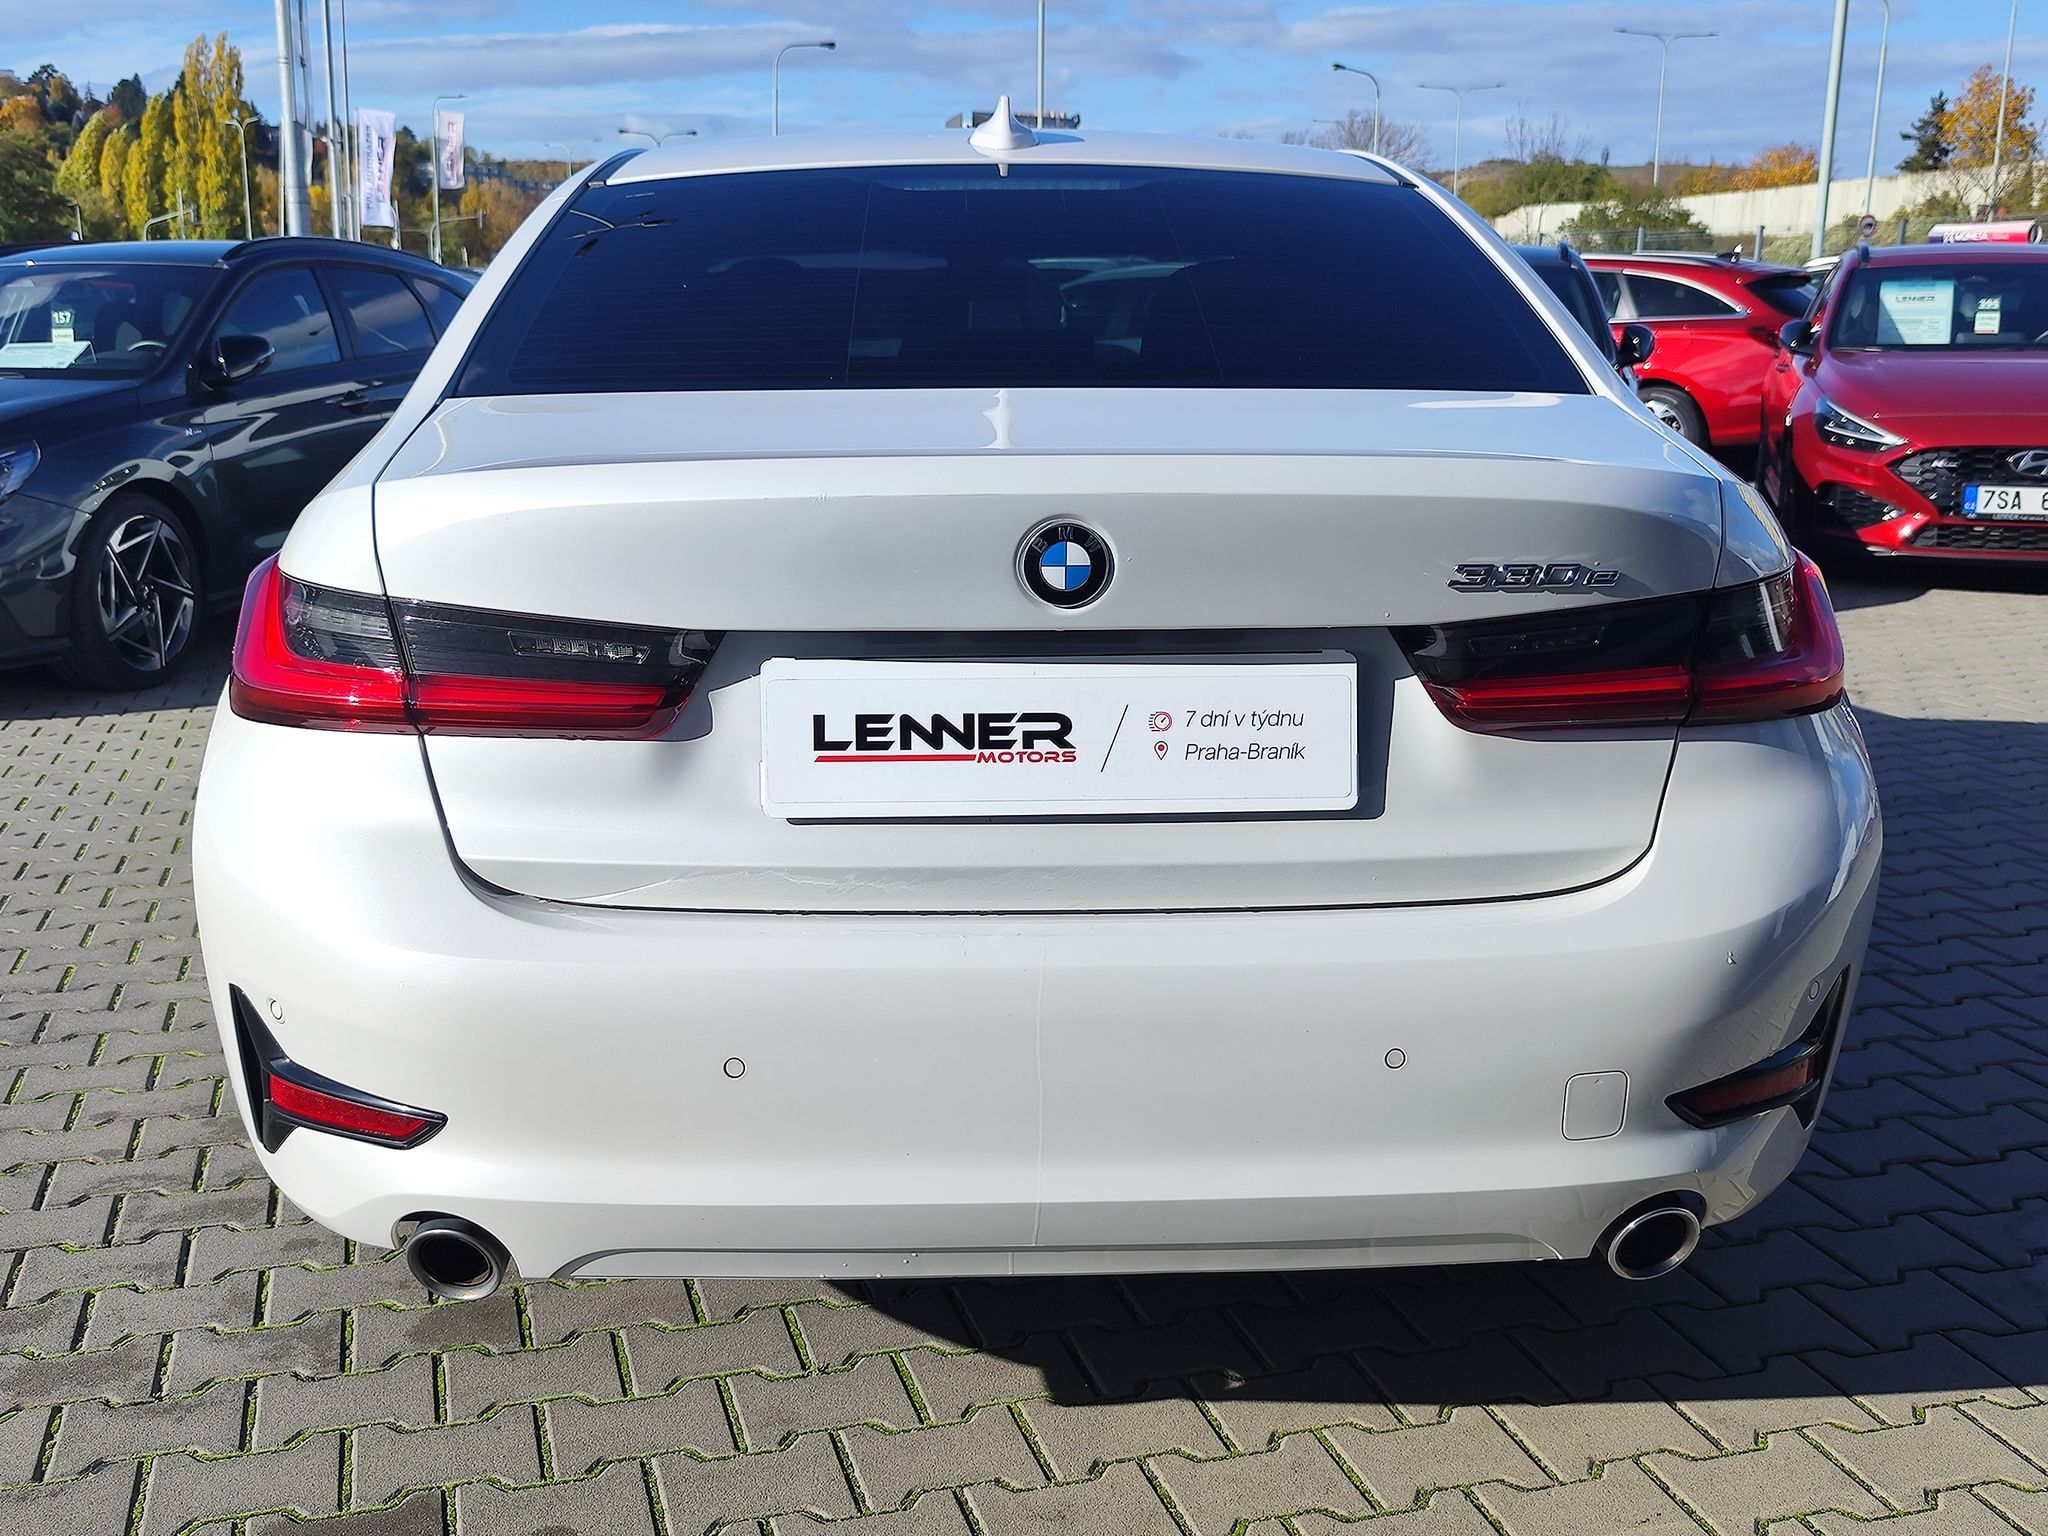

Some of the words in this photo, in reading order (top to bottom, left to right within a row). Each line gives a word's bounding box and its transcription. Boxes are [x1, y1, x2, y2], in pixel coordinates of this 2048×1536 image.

[53, 310, 72, 324] 157
[1983, 490, 2021, 510] 7SA
[1031, 526, 1101, 554] BMW
[1446, 563, 1622, 588] 330e
[1186, 710, 1197, 727] 7
[1200, 709, 1231, 728] dní
[1234, 713, 1246, 727] v
[1251, 709, 1304, 731] týdnu
[813, 713, 1077, 751] LENNER
[976, 750, 1077, 764] MOTORS
[1184, 742, 1306, 761] Praha-Braník
